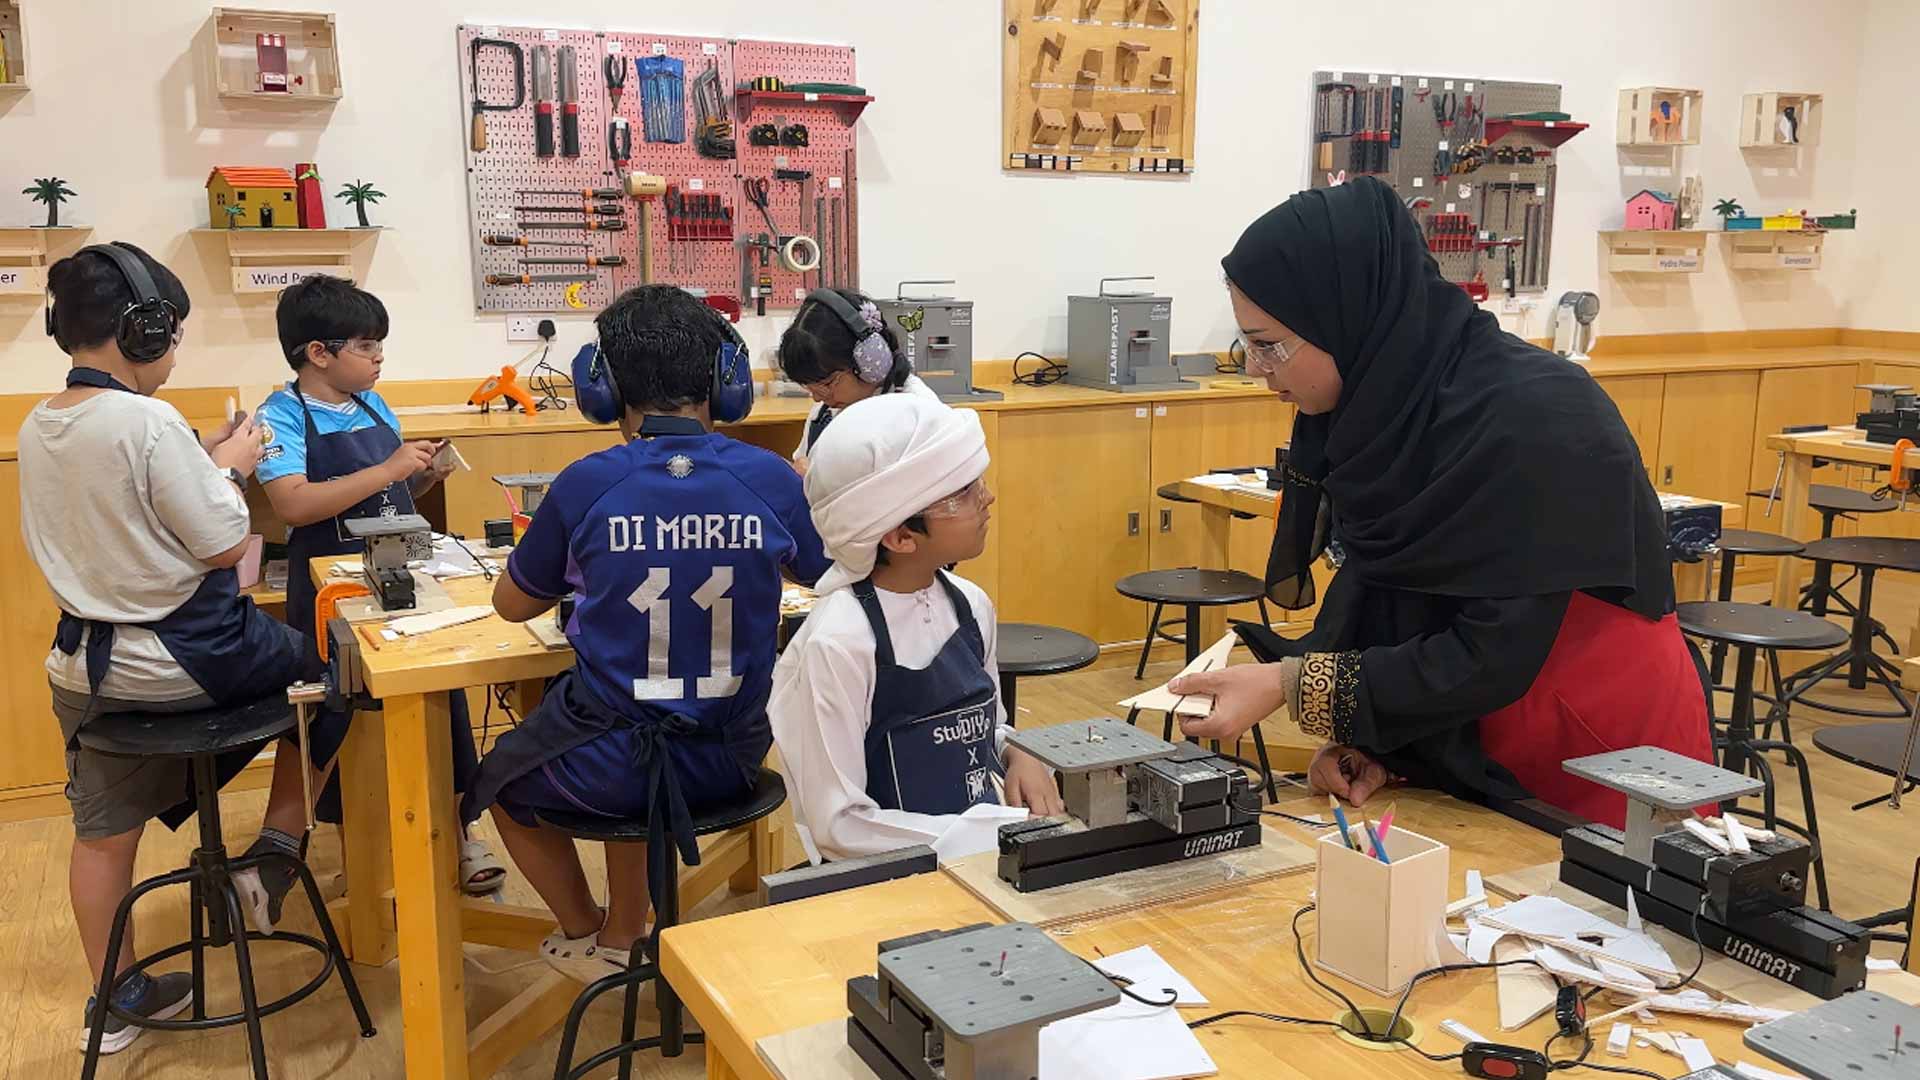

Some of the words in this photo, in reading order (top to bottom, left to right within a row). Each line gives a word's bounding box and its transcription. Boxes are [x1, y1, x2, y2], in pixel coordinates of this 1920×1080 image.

[0, 273, 17, 283] er
[251, 272, 288, 284] Wind
[1679, 259, 1697, 268] Power
[1109, 305, 1119, 385] FLAMEFAST
[608, 515, 646, 551] DI
[656, 514, 763, 551] MARIA
[626, 566, 744, 700] 11
[1183, 830, 1244, 858] UNIMAT
[1723, 936, 1801, 983] UNIMAT
